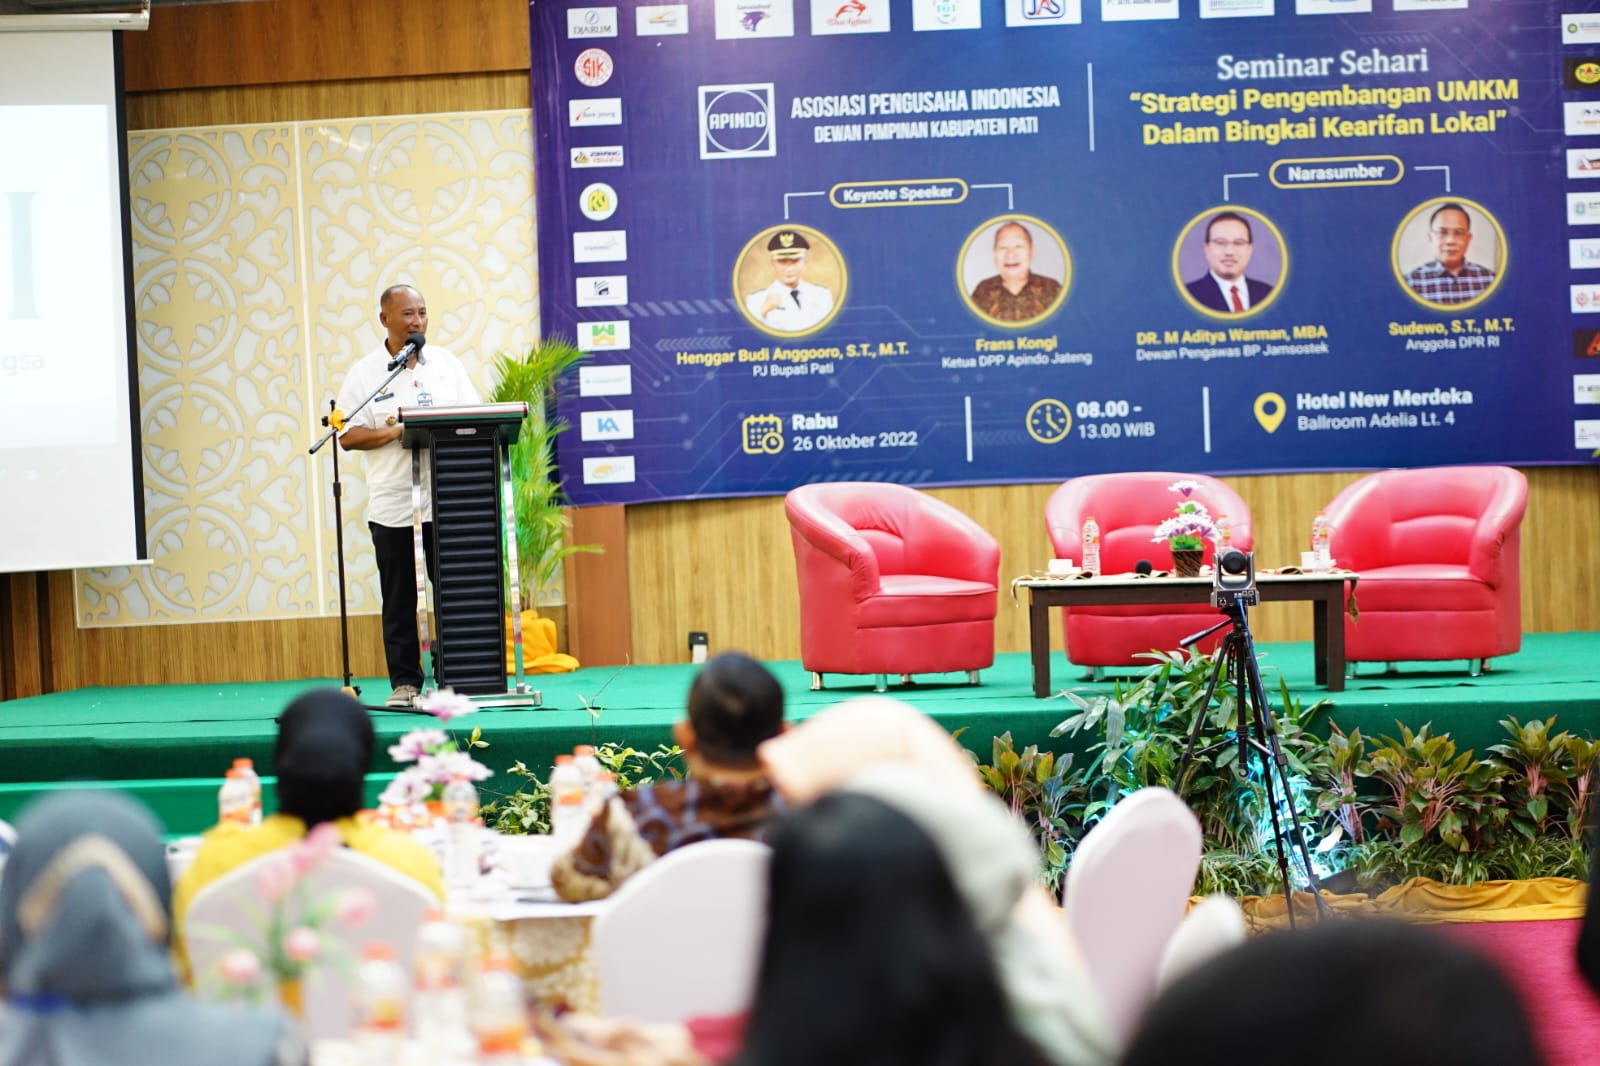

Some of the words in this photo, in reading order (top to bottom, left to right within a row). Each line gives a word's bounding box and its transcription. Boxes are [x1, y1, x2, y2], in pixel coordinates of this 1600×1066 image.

[1217, 54, 1334, 80] Seminar
[1340, 48, 1429, 74] Sehari
[791, 95, 866, 118] ASOSIASI
[869, 90, 968, 115] PENGUSAHA
[972, 86, 1060, 110] INDONESIA
[1130, 89, 1237, 116] “Strategi
[1244, 84, 1431, 111] Pengembangan
[1438, 79, 1518, 102] UMKM
[710, 112, 768, 129] APINDO
[814, 124, 862, 143] DEWAN
[864, 122, 928, 140] PIMPINAN
[930, 118, 1009, 137] KABUPATEN
[1010, 116, 1038, 134] PATI
[1143, 122, 1219, 145] Dalam
[1225, 117, 1316, 145] Bingkai
[1323, 113, 1424, 137] Kearifan
[1431, 110, 1506, 133] Lokal”
[1288, 166, 1383, 182] Narasumber
[843, 189, 898, 204] Keynote
[1136, 332, 1161, 345] DR.
[1164, 331, 1178, 343] M
[1181, 330, 1226, 345] Aditya
[1229, 329, 1290, 341] Warman,
[1293, 325, 1328, 339] MBA
[1389, 321, 1448, 335] Sudewo,
[1451, 319, 1481, 334] S.T.,
[1485, 318, 1514, 332] M.T.
[976, 339, 1014, 351] Frans
[1017, 335, 1057, 352] Kongi
[1136, 349, 1177, 361] Dewan
[1179, 347, 1241, 361] Pengawas
[1243, 344, 1260, 357] BP
[1406, 338, 1456, 352] Anggota
[1459, 336, 1485, 348] DPR
[1487, 335, 1499, 347] RI
[677, 352, 735, 366] Henggar
[738, 348, 769, 362] Budi
[879, 342, 909, 355] M.T.
[942, 357, 977, 368] Ketua
[979, 354, 1005, 367] DPP
[1007, 353, 1049, 367] Apindo
[1050, 350, 1092, 365] Jateng
[770, 364, 808, 377] Bupati
[810, 363, 834, 374] Pati
[1297, 391, 1345, 410] Hotel
[1350, 391, 1389, 408] New
[1393, 387, 1473, 406] Merdeka
[1077, 400, 1129, 418] 08.00
[792, 412, 838, 430] Rabu
[1078, 423, 1121, 438] 13.00
[1124, 422, 1155, 437] WIB
[1298, 415, 1366, 431] Ballroom
[1369, 412, 1417, 427] Adelia
[1421, 412, 1440, 426] Lt.
[1445, 411, 1455, 424] 4
[793, 436, 813, 451] 26
[816, 434, 876, 450] Oktober
[879, 431, 918, 447] 2022
